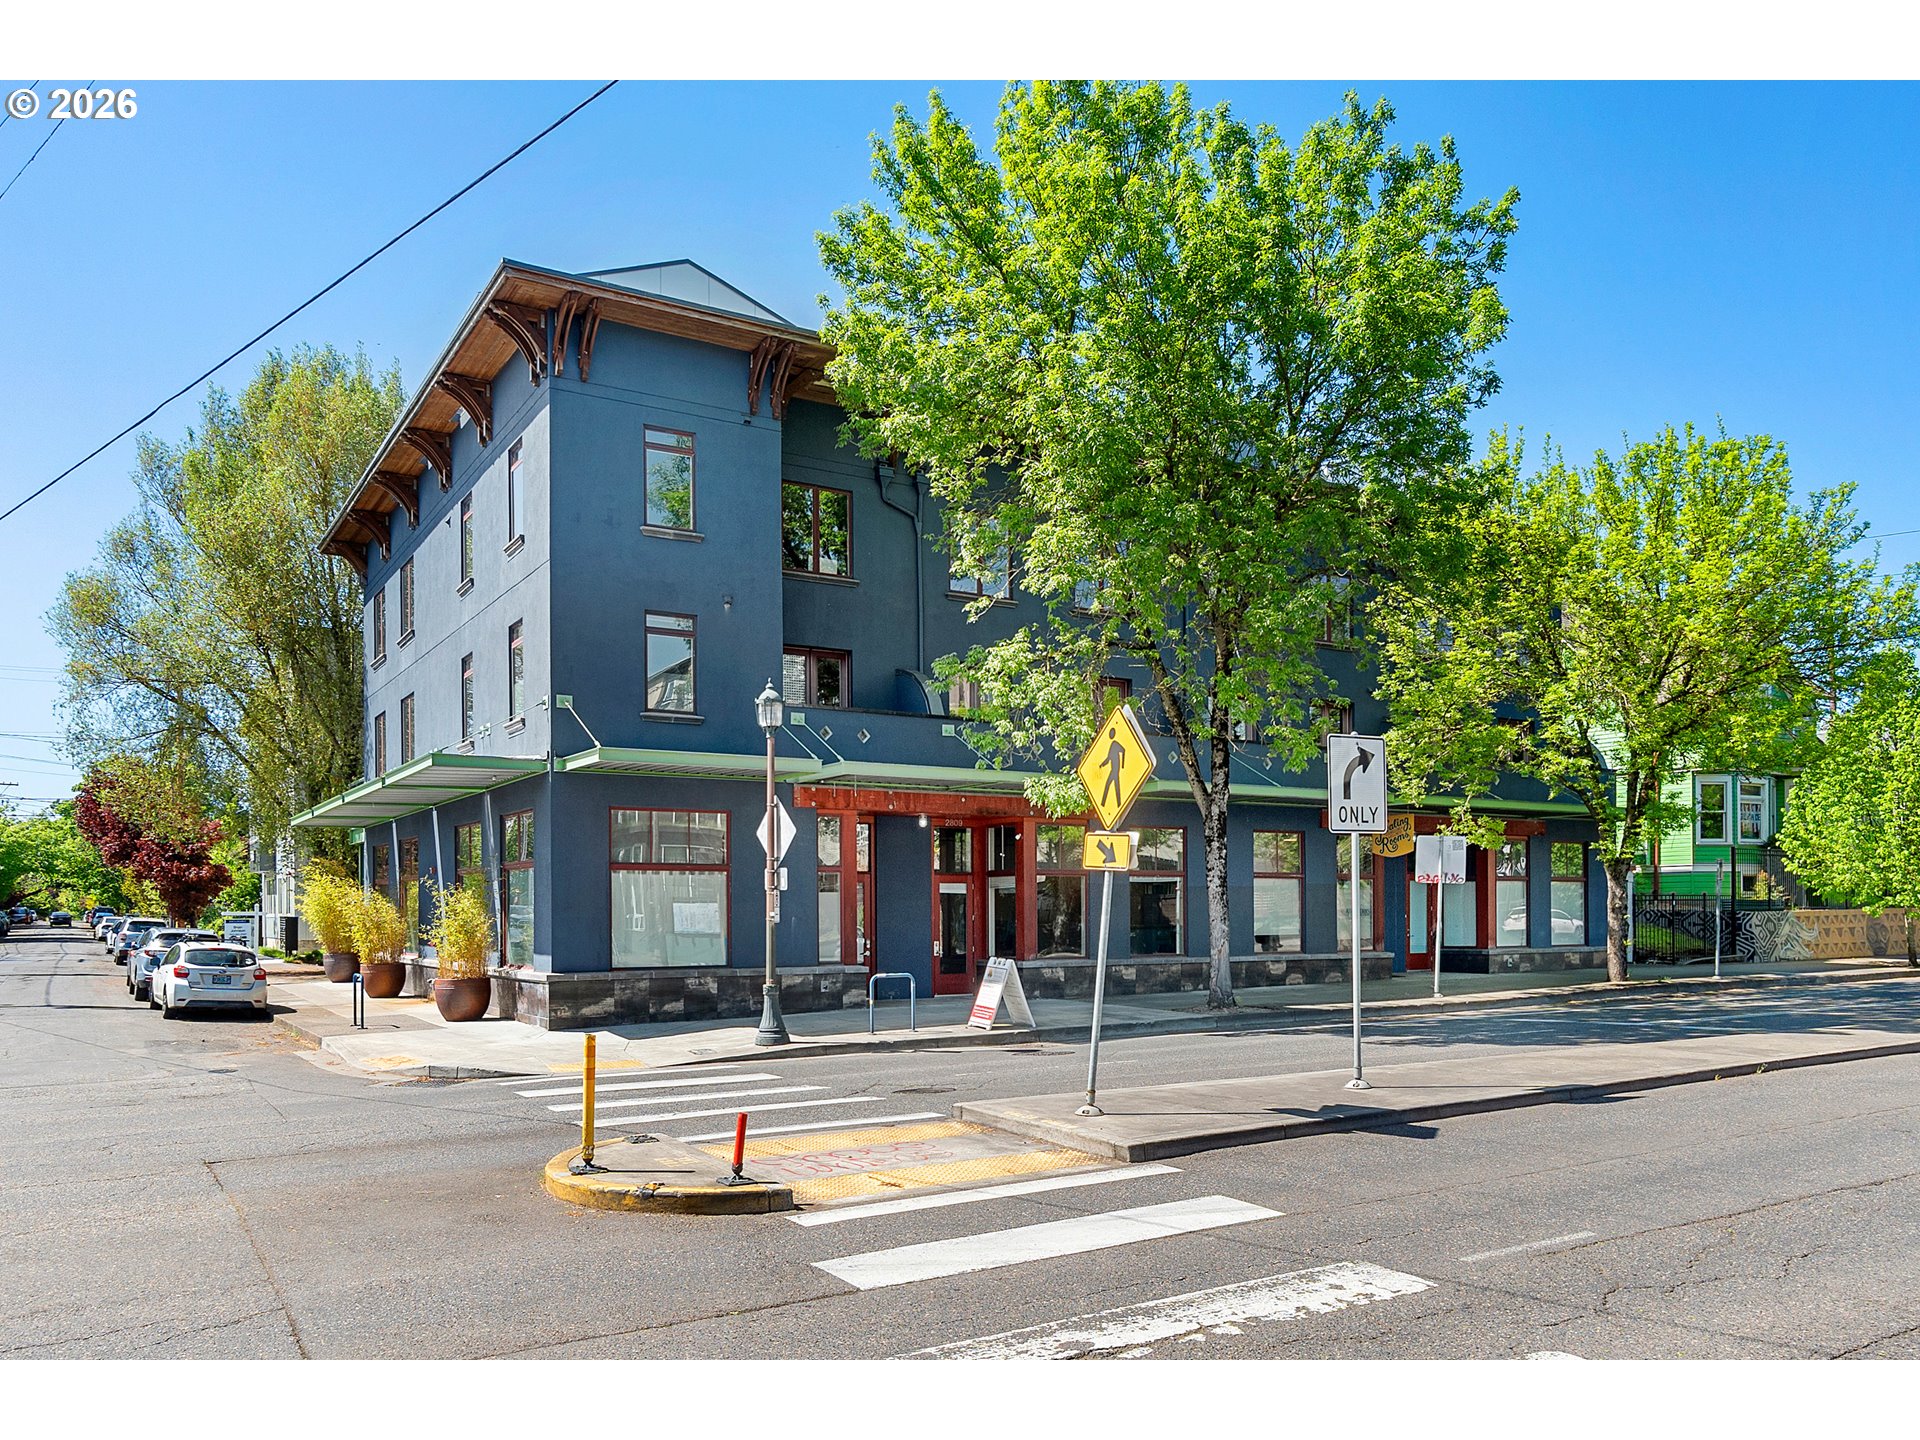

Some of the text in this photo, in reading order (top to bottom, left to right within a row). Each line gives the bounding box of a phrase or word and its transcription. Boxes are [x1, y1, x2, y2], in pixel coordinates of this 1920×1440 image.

[945, 819, 963, 827] 2809
[1338, 806, 1378, 824] ONLY
[1375, 833, 1411, 854] Rooms
